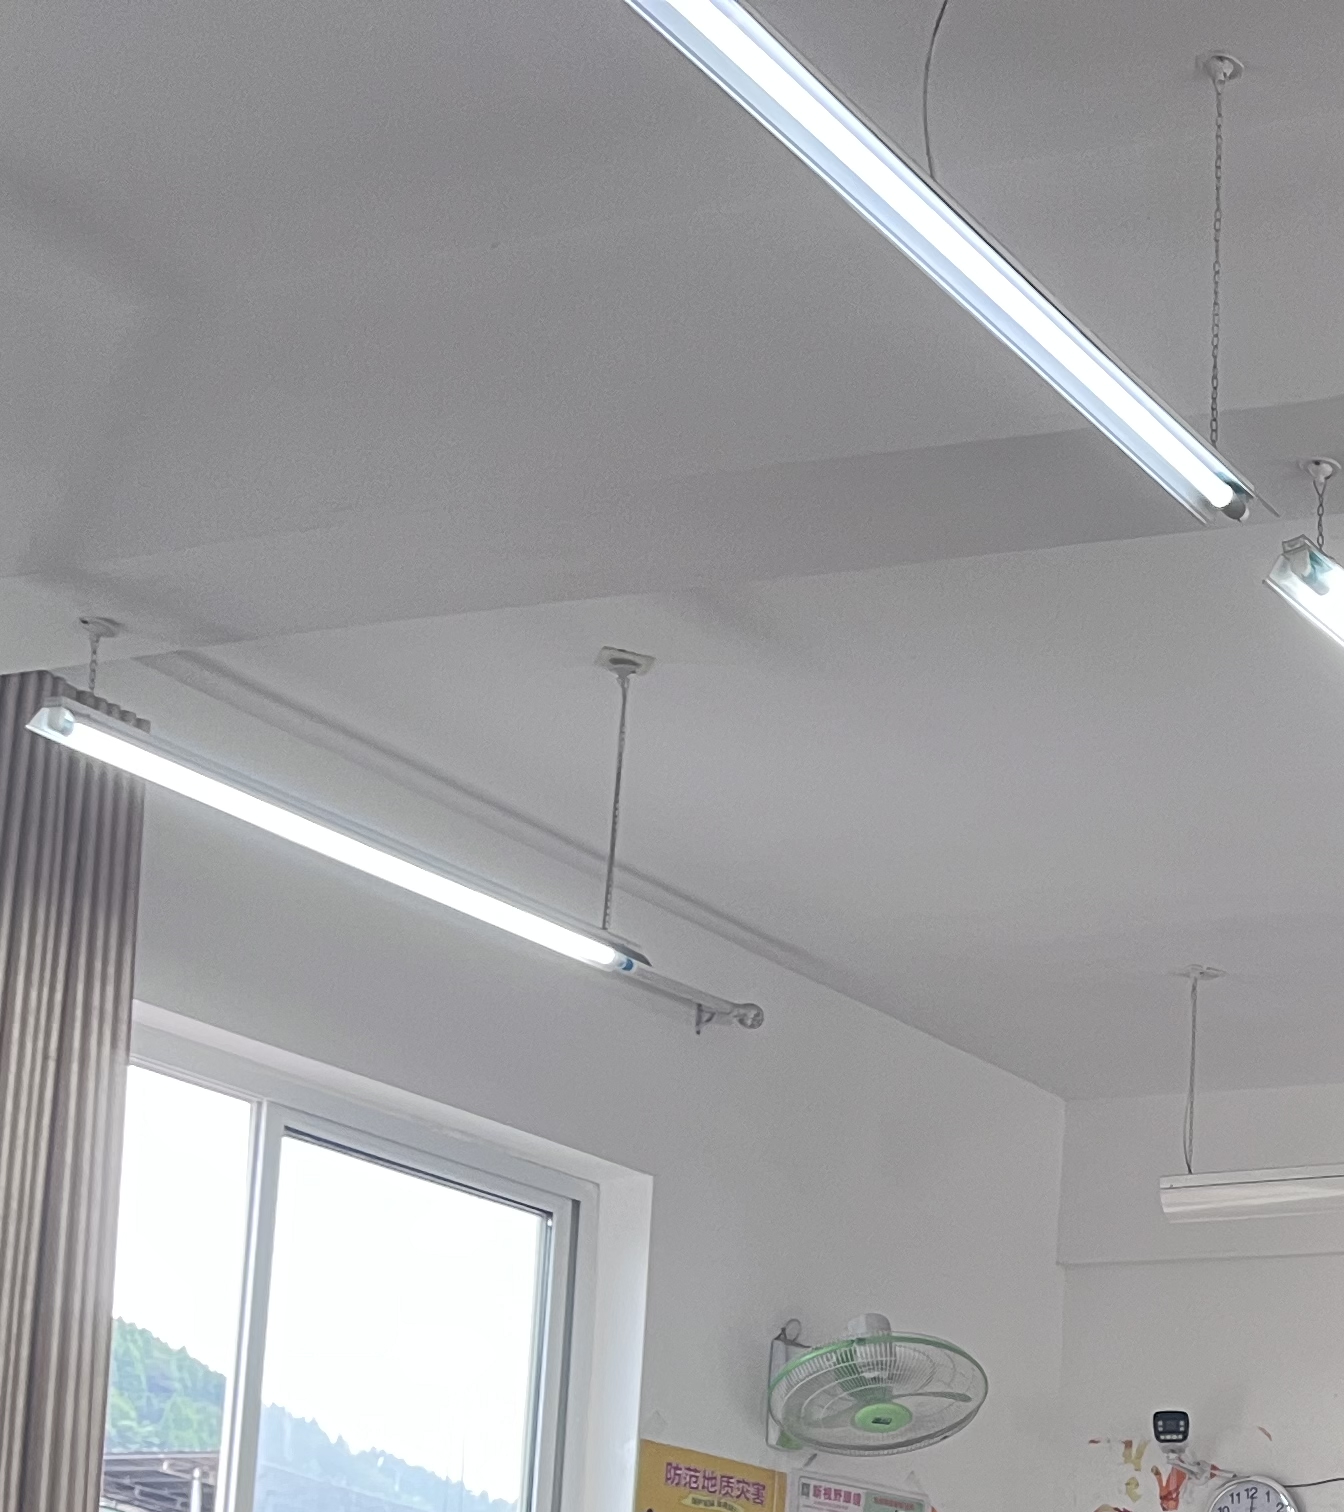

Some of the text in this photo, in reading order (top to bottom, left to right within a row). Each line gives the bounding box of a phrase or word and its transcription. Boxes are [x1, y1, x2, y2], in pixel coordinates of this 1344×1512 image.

[664, 1462, 767, 1505] 防范地质灾害
[1229, 1492, 1241, 1504] 11
[1244, 1486, 1258, 1500] 12
[1265, 1490, 1271, 1503] 1
